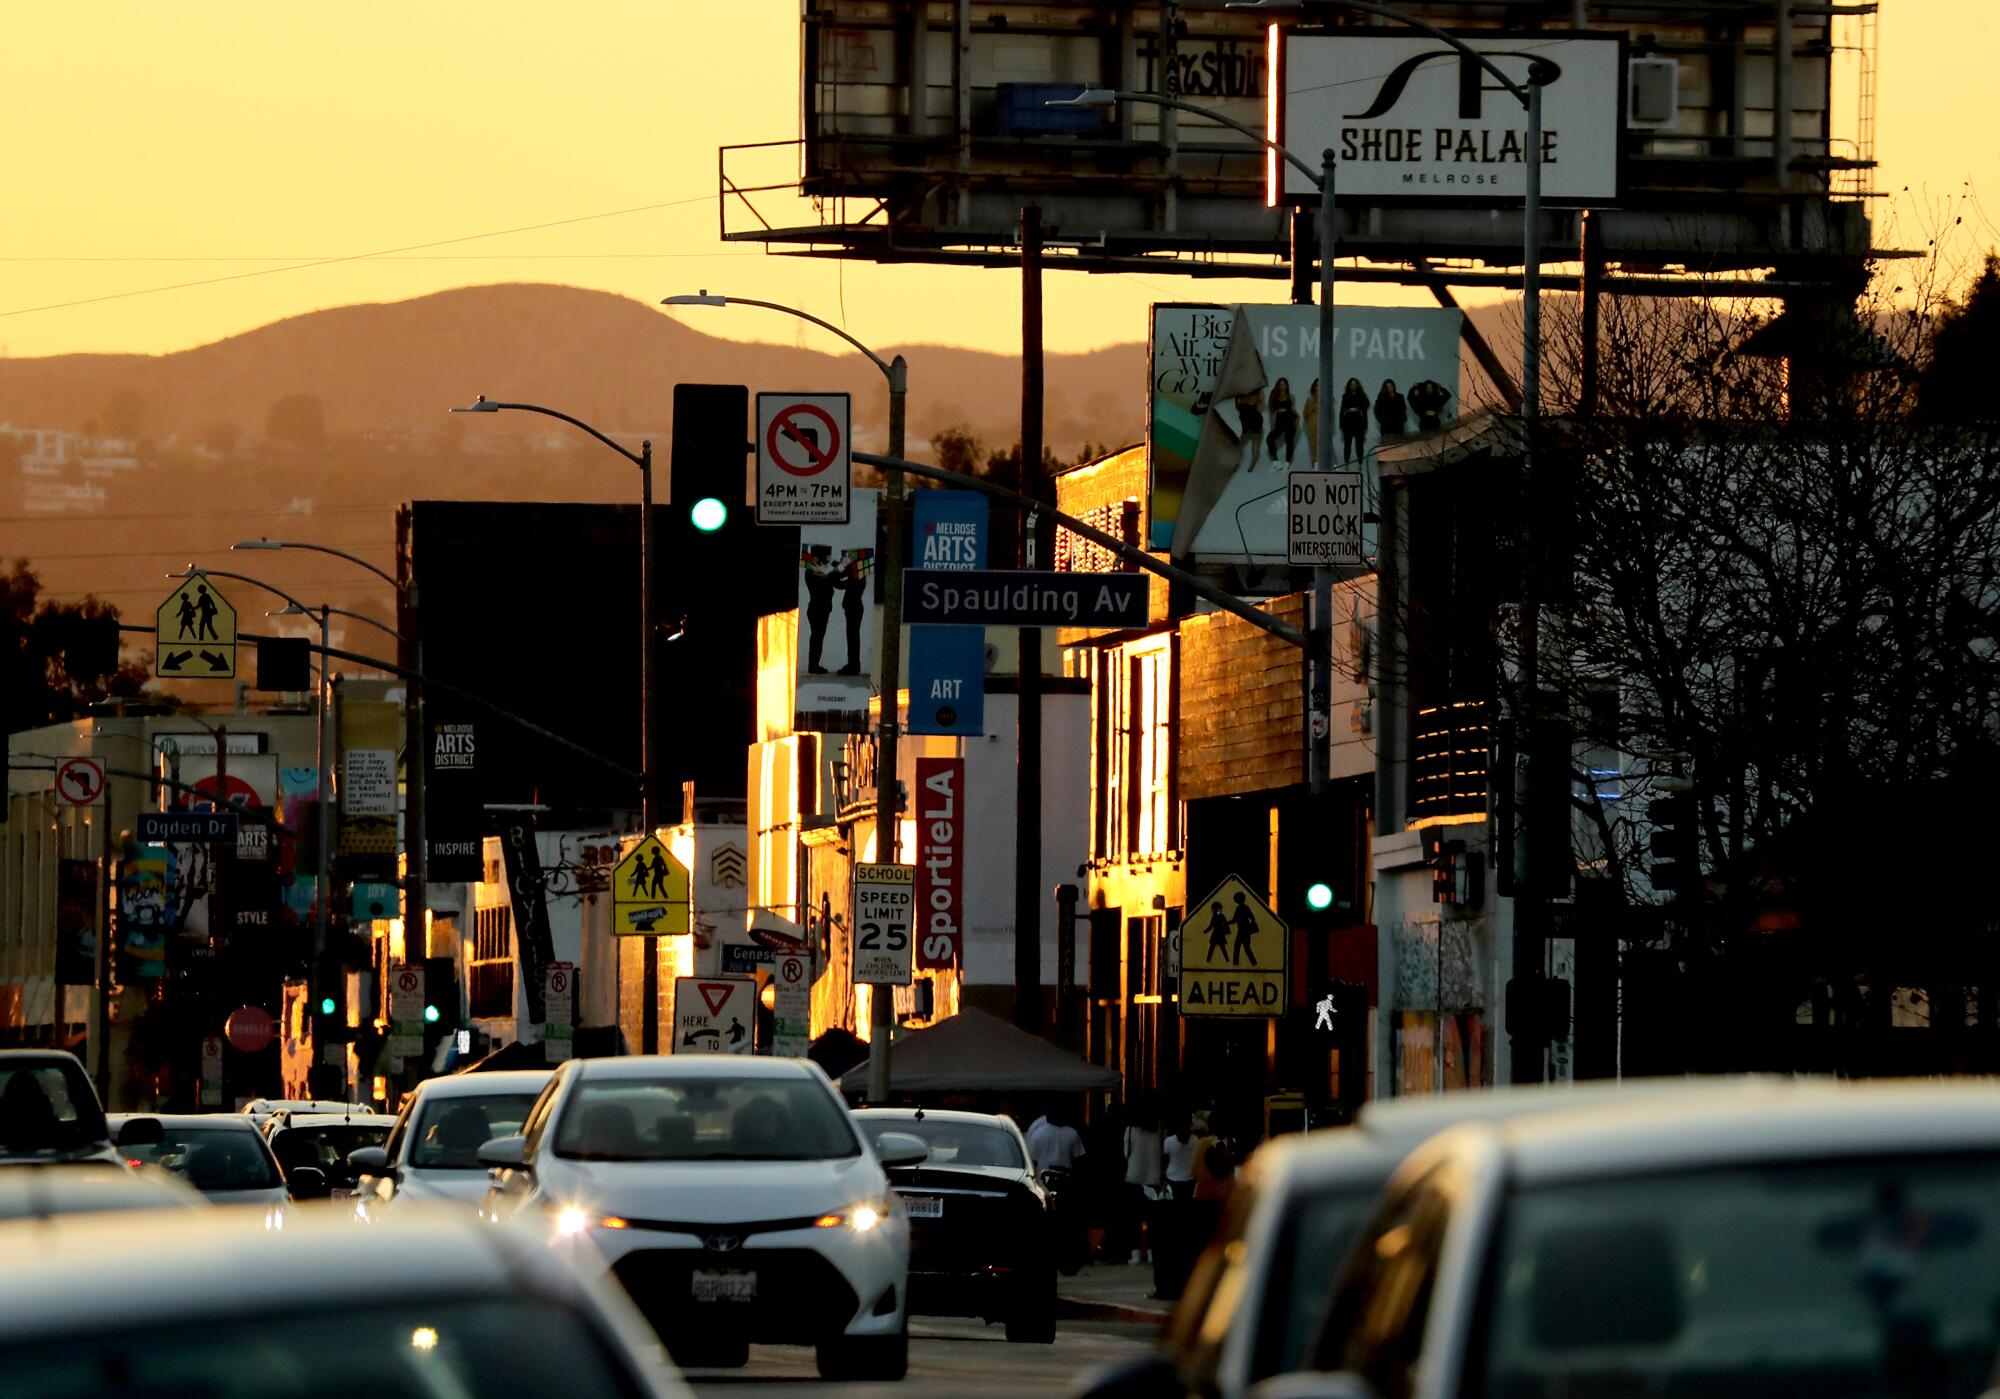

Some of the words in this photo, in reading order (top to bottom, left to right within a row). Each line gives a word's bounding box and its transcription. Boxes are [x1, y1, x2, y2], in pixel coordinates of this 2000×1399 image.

[1341, 128, 1423, 162] SHOE
[1435, 128, 1558, 163] PALAE
[1402, 174, 1499, 185] MELROSE
[1192, 314, 1232, 349] Big
[1262, 325, 1288, 357] IS
[1299, 327, 1340, 358] M
[1351, 328, 1426, 360] PARK
[1179, 350, 1226, 377] Wit
[765, 484, 797, 498] 4PM
[811, 484, 842, 498] 7PM
[1292, 484, 1315, 505] DO
[1325, 484, 1359, 505] NOT
[828, 500, 843, 508] SUN
[936, 523, 977, 536] MELROSE
[1292, 514, 1358, 535] BLOCK
[923, 536, 977, 562] ARTS
[1292, 541, 1360, 556] INTERSECTION
[921, 583, 1079, 620] Spaulding
[1094, 585, 1132, 613] Av
[931, 679, 963, 700] ART
[444, 723, 475, 734] MELROSE
[435, 734, 475, 753] ARTS
[434, 753, 475, 766] DISTRICT
[147, 819, 202, 838] Ogden
[208, 819, 228, 834] Dr
[237, 831, 268, 846] ARTS
[435, 842, 476, 855] INSPIRE
[923, 769, 957, 960] SportieLA
[859, 868, 911, 881] SCHOOL
[860, 892, 910, 905] SPEED
[236, 911, 269, 925] STYLE
[864, 907, 904, 920] LIMIT
[859, 922, 908, 951] 25
[734, 947, 776, 960] Genese
[1187, 981, 1279, 1005] AHEAD
[683, 1016, 709, 1027] HERE
[707, 1039, 720, 1050] TO
